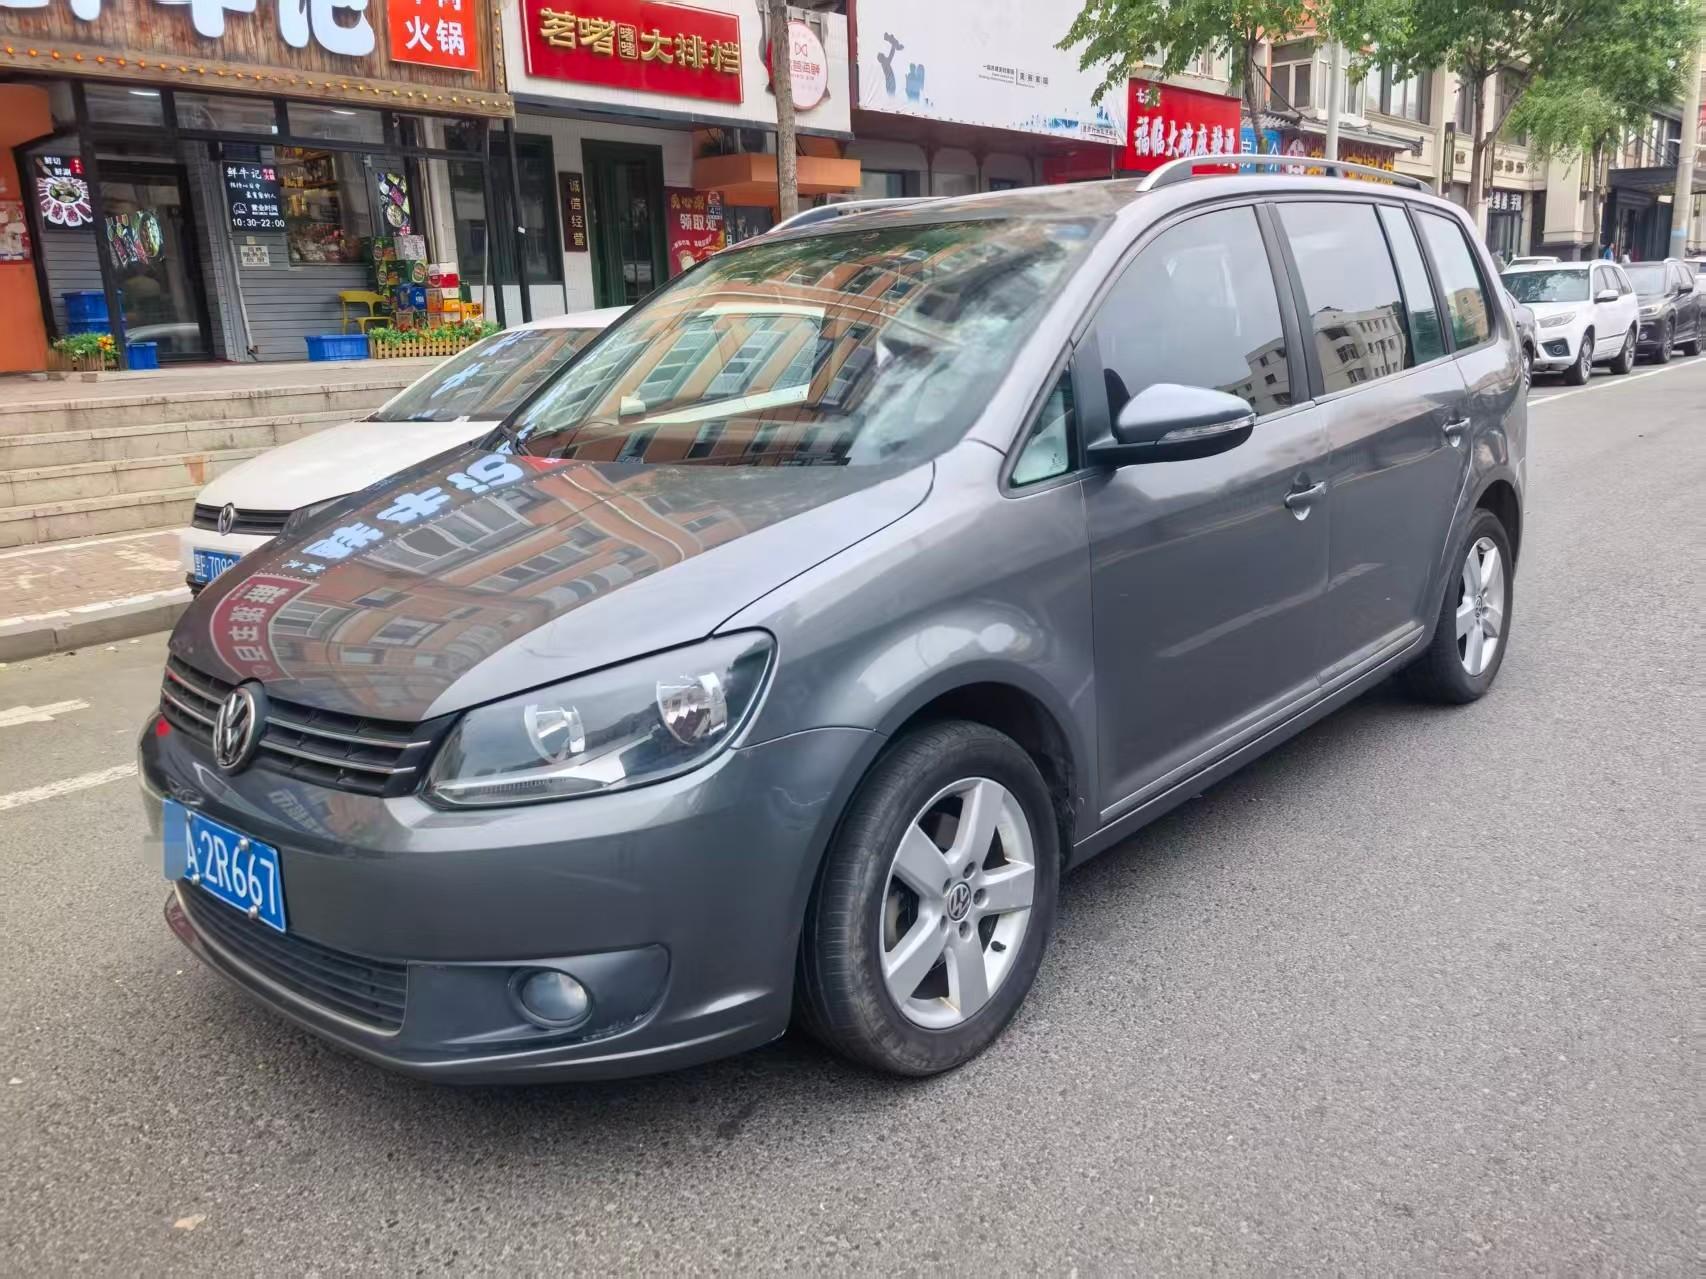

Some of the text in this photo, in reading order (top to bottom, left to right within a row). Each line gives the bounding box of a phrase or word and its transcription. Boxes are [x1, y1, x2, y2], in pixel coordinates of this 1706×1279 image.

[405, 16, 466, 56] 火锅
[640, 28, 741, 75] 大排档
[232, 218, 285, 228] 10:30-22:00
[568, 178, 585, 247] 诚信经营
[680, 213, 718, 231] 领取处
